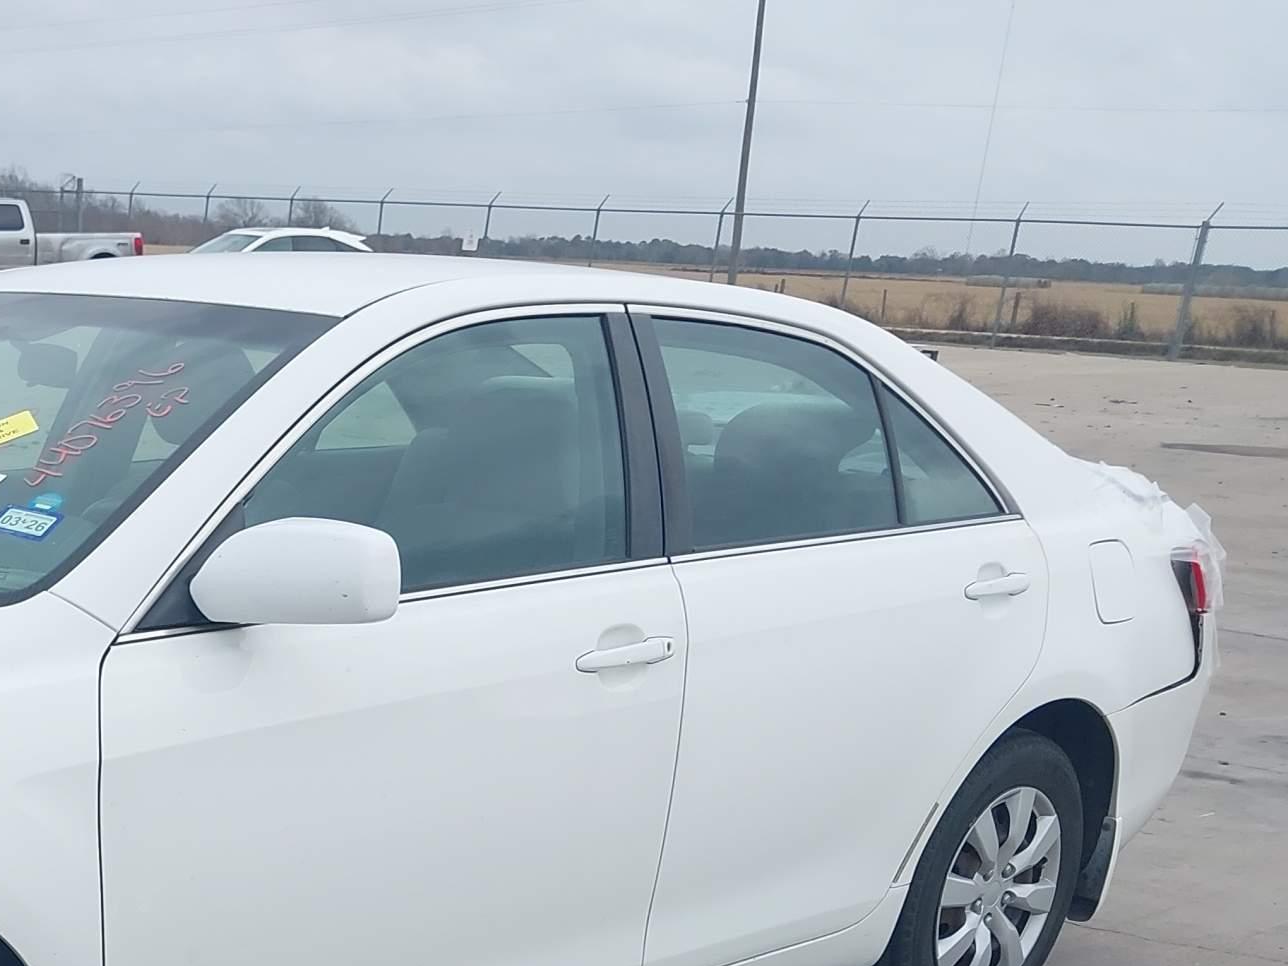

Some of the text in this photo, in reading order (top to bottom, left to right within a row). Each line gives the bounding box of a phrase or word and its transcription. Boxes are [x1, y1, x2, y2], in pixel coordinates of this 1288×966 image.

[23, 362, 185, 487] 44076396
[0, 515, 48, 532] 03 26
